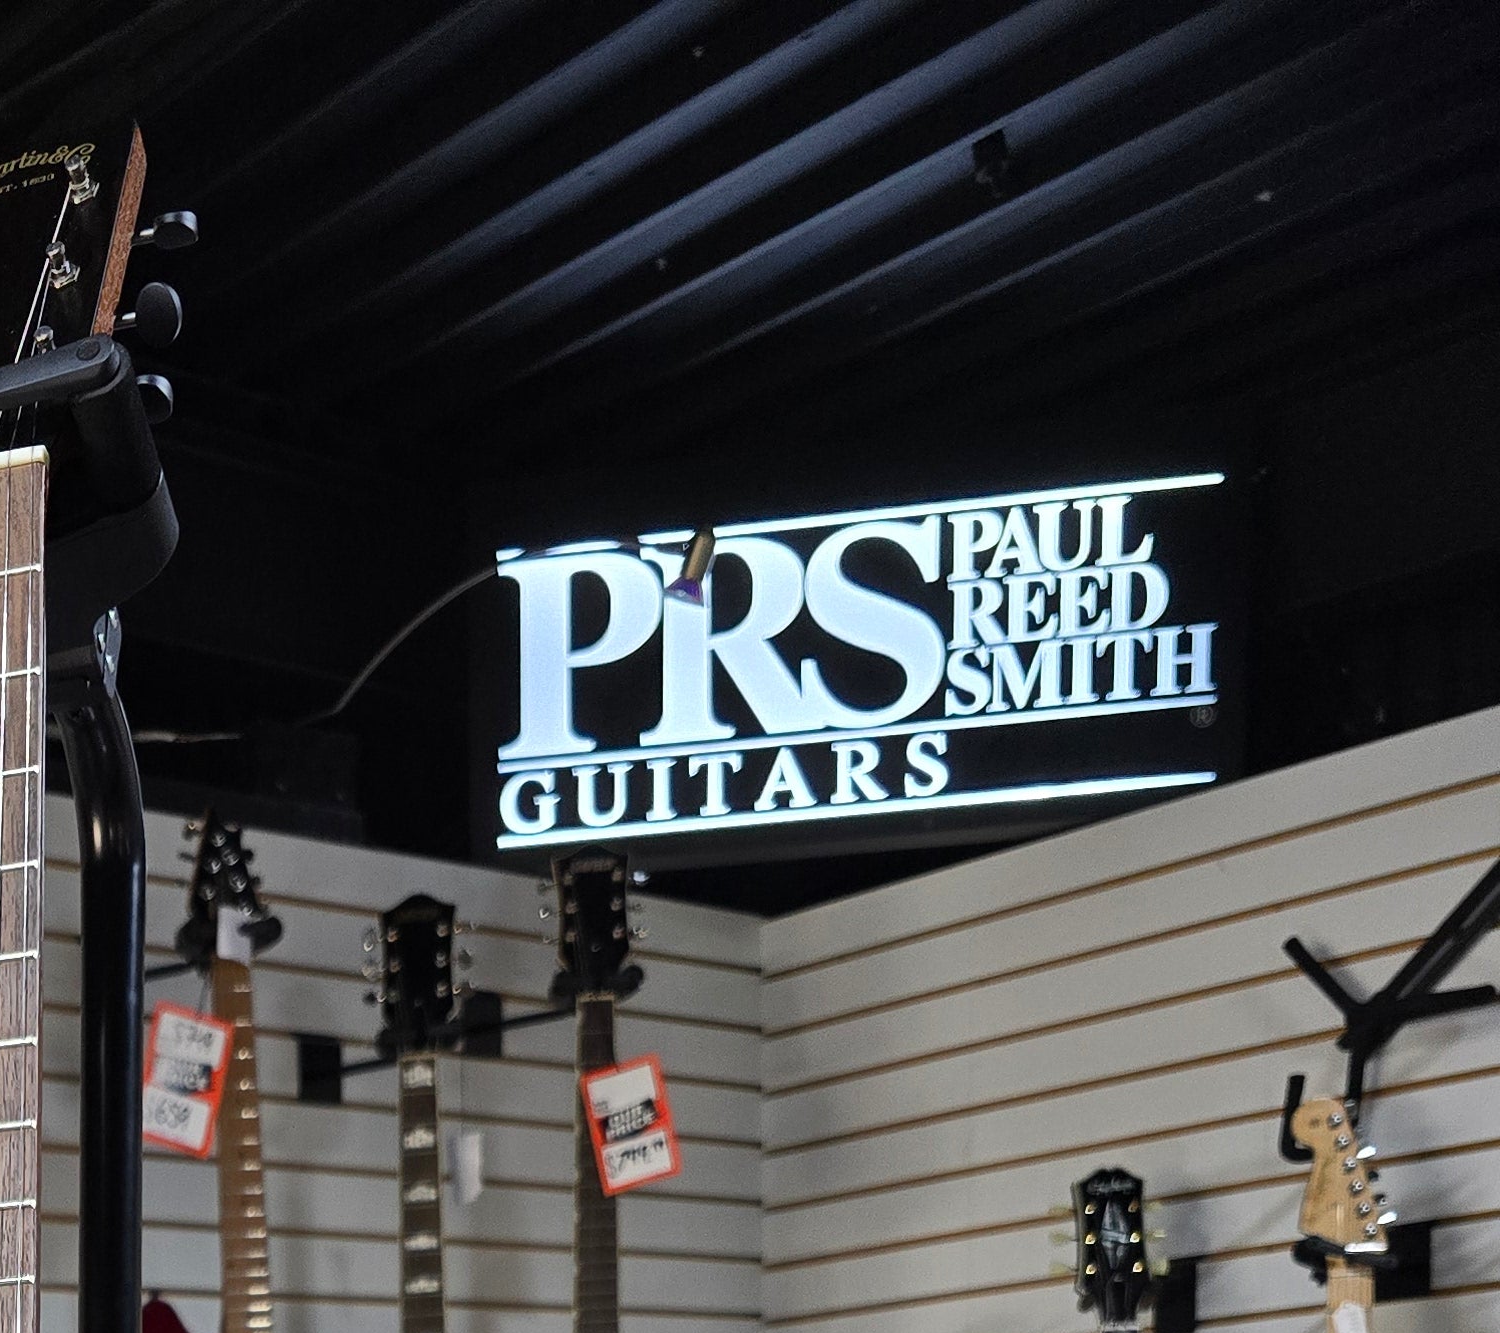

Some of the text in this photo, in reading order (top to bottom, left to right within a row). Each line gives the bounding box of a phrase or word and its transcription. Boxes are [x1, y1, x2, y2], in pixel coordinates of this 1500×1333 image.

[947, 495, 1154, 583] PAUL
[499, 514, 944, 757] PRS
[948, 563, 1170, 648] REED
[945, 623, 1218, 716] SMITH
[500, 732, 950, 834] GUITARS
